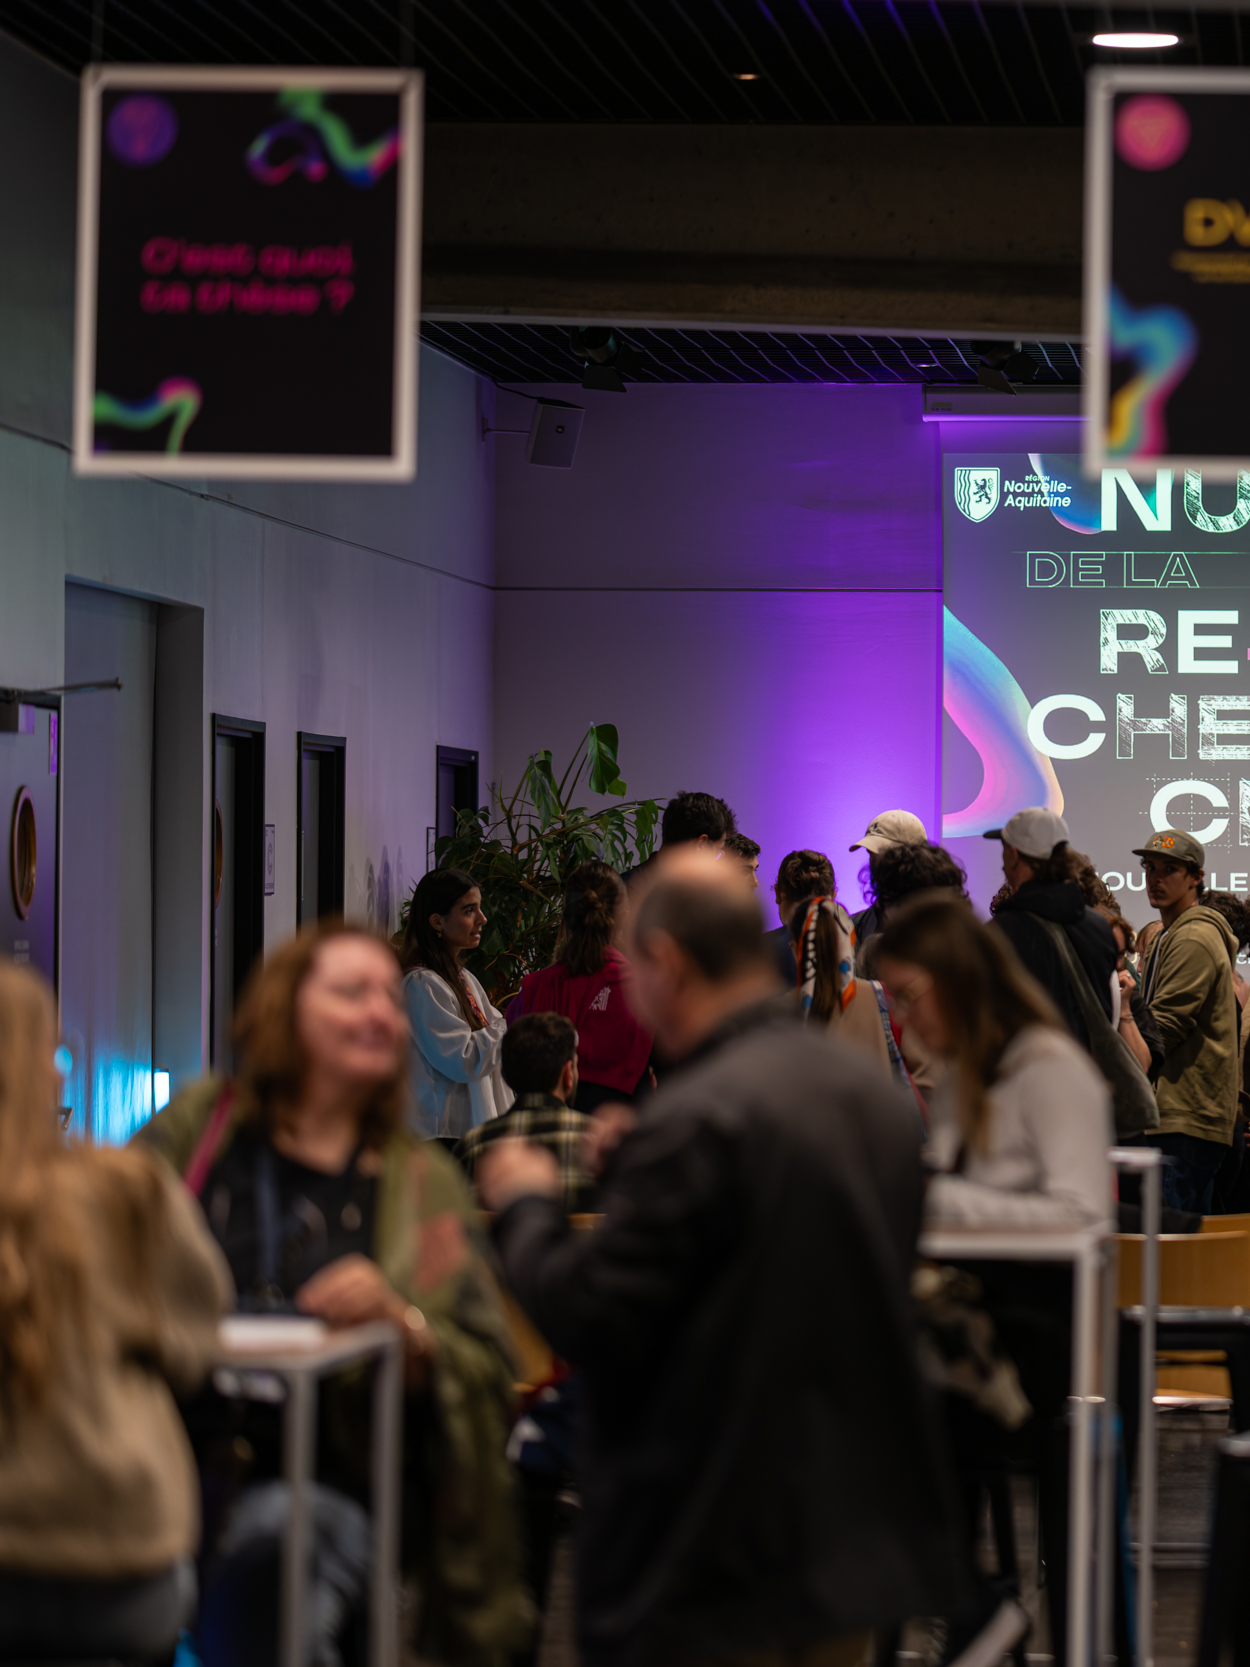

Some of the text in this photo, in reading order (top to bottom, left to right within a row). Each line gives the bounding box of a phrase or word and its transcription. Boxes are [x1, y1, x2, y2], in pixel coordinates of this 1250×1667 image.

[1004, 480, 1072, 493] Nouvelle-
[1004, 494, 1071, 511] Aquitaine
[1026, 551, 1200, 588] DE LA
